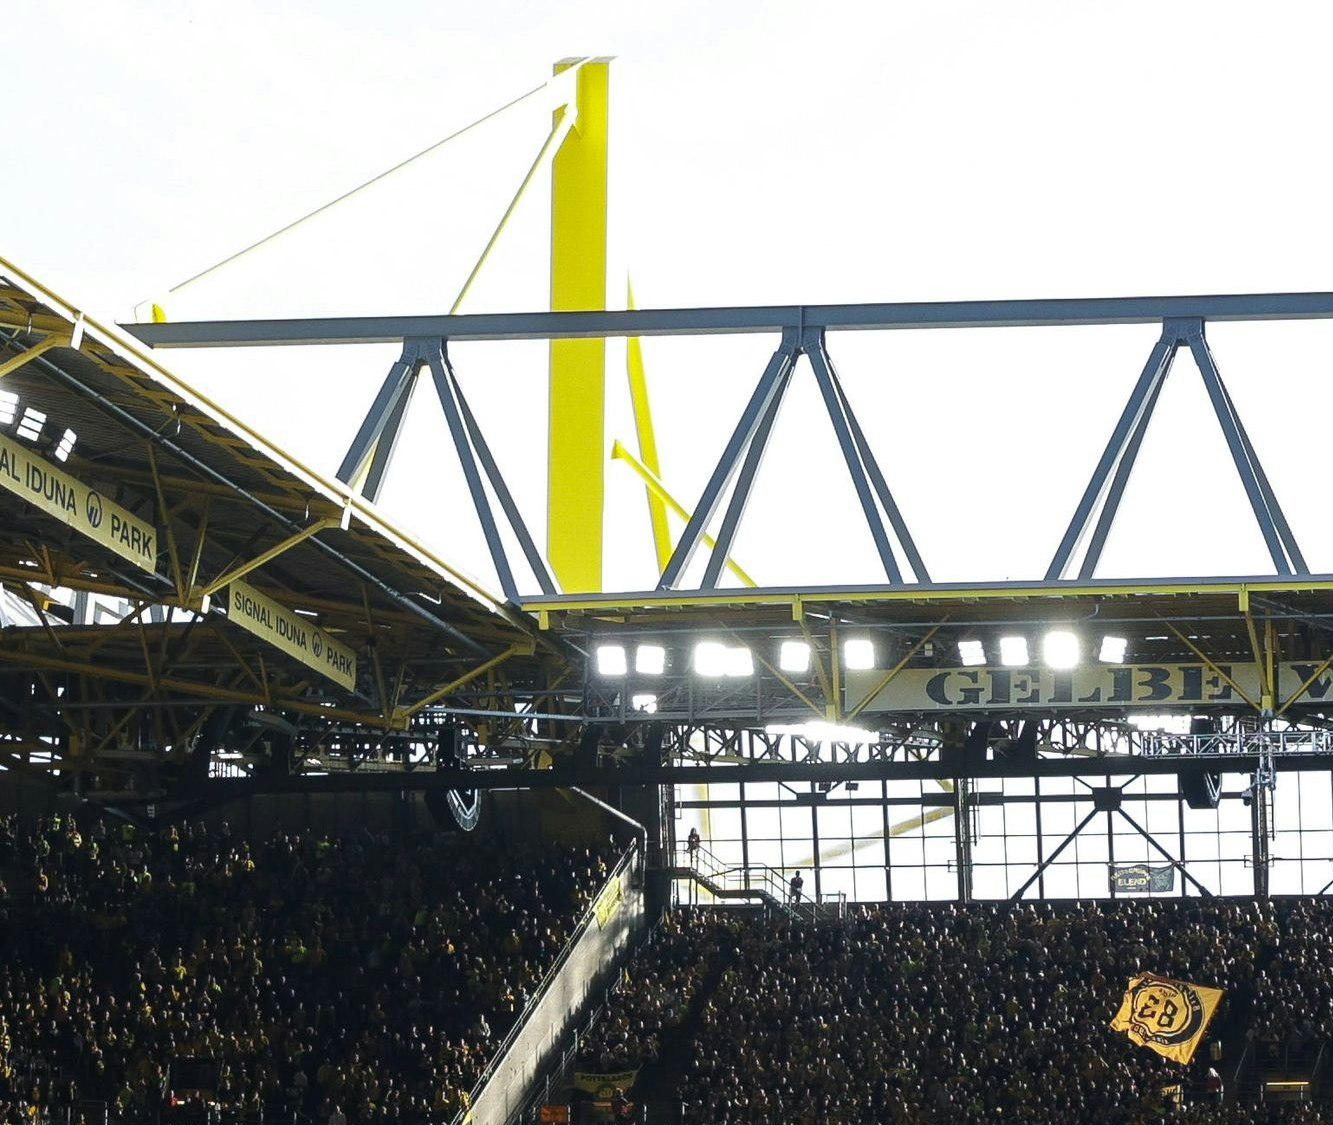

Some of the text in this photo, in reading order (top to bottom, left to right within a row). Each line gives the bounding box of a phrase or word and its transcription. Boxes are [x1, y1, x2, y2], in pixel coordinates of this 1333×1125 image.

[26, 461, 76, 516] IDUNA
[111, 513, 152, 560] PARK
[234, 591, 353, 678] SIGNAL IDUNA PARK
[925, 666, 1233, 706] GELBE
